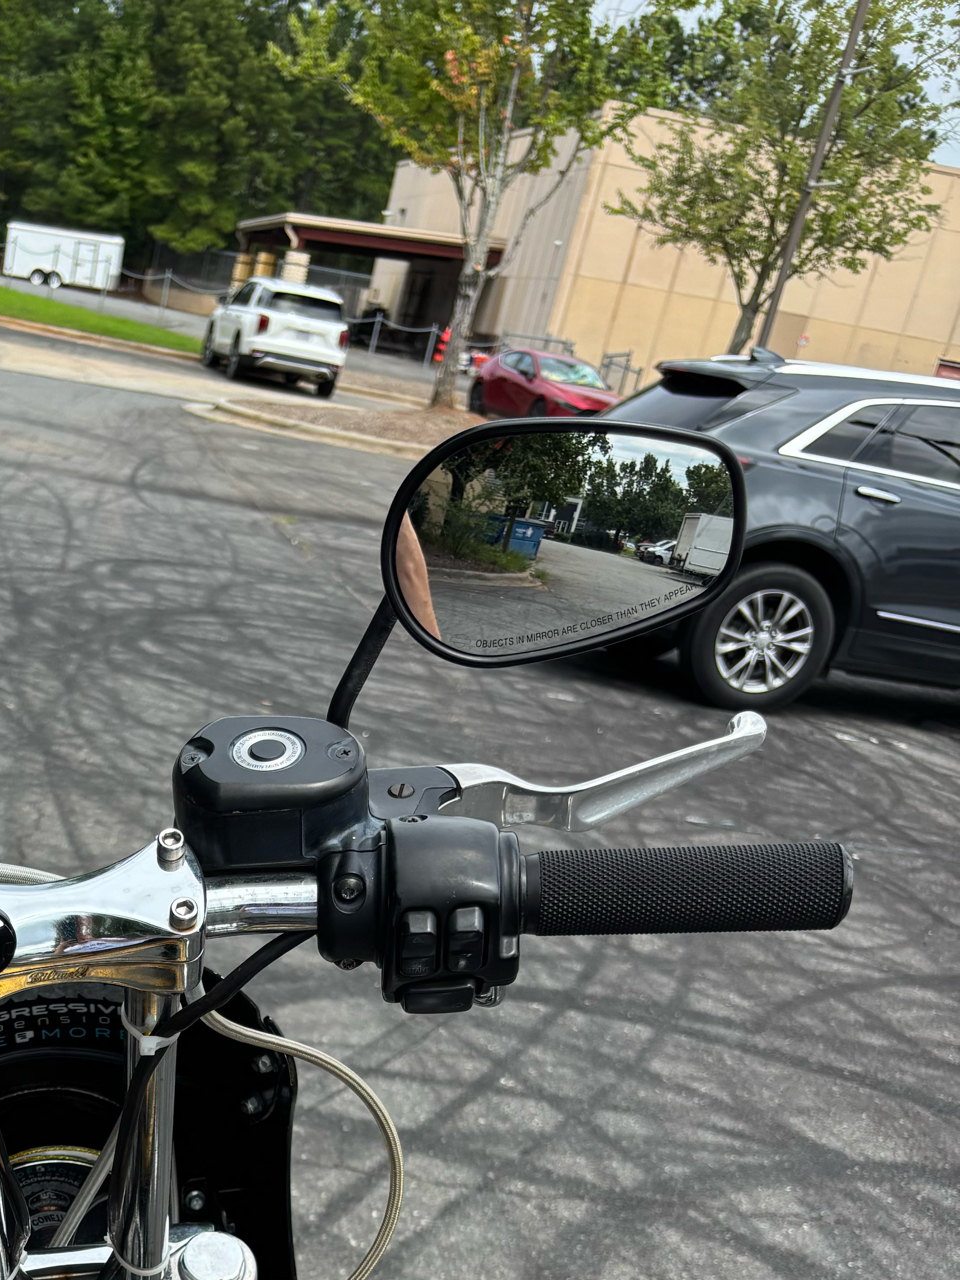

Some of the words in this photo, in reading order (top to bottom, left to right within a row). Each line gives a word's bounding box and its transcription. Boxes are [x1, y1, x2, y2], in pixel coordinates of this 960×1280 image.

[475, 637, 514, 648] OBJECTS
[515, 635, 525, 645] IN
[526, 628, 560, 643] MIRROR
[561, 623, 579, 636] ARE
[580, 614, 614, 631] CLOSER
[615, 605, 638, 620] THAN
[639, 596, 661, 612] THEY
